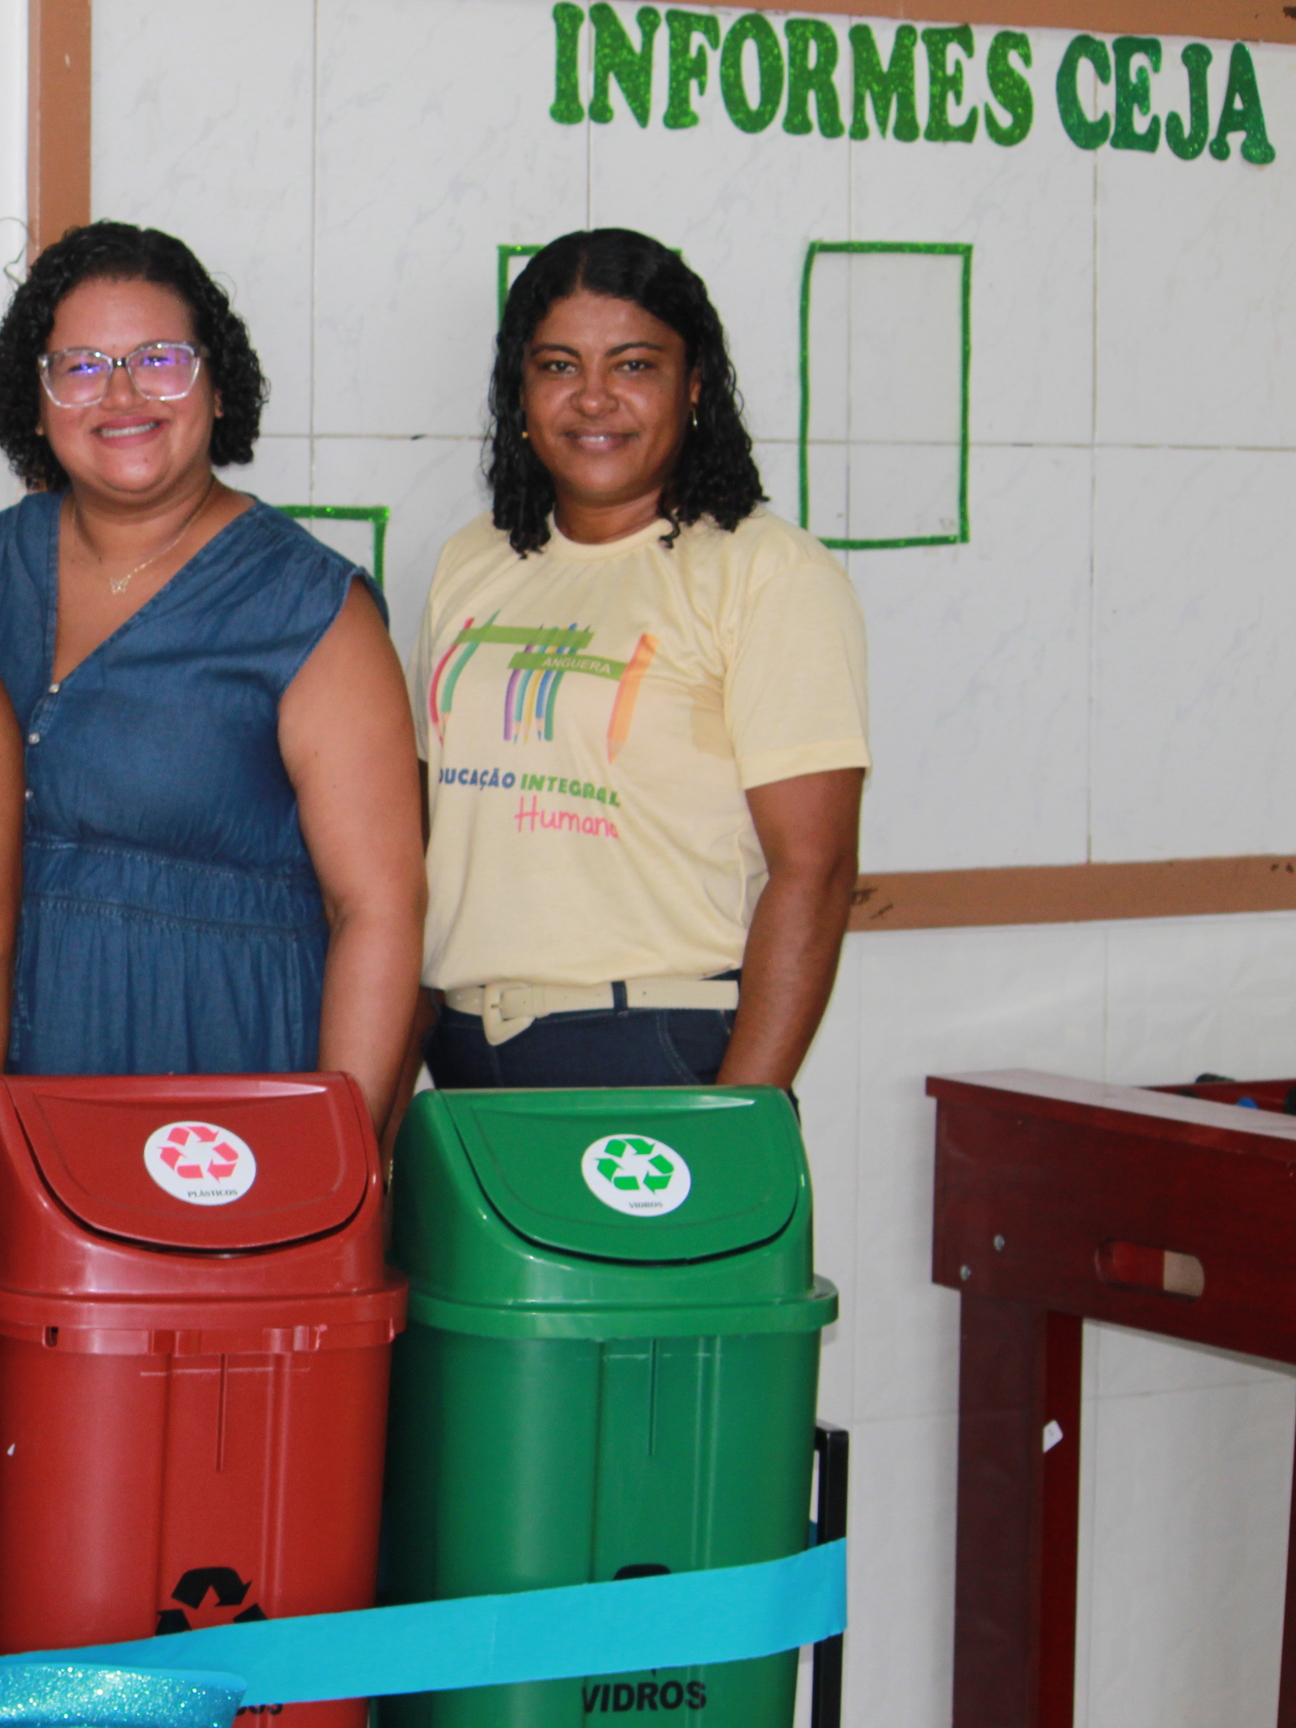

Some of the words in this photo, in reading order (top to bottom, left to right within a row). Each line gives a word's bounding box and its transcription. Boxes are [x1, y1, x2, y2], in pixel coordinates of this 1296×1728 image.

[549, 2, 1035, 147] INFORMES
[1056, 34, 1276, 165] CEJA
[541, 657, 611, 675] ANGUERA
[438, 767, 516, 791] UCAÇÃO
[520, 773, 621, 808] INTEGRAL
[187, 1188, 238, 1198] PLÁSTICOS
[581, 1680, 708, 1714] VIDROS
